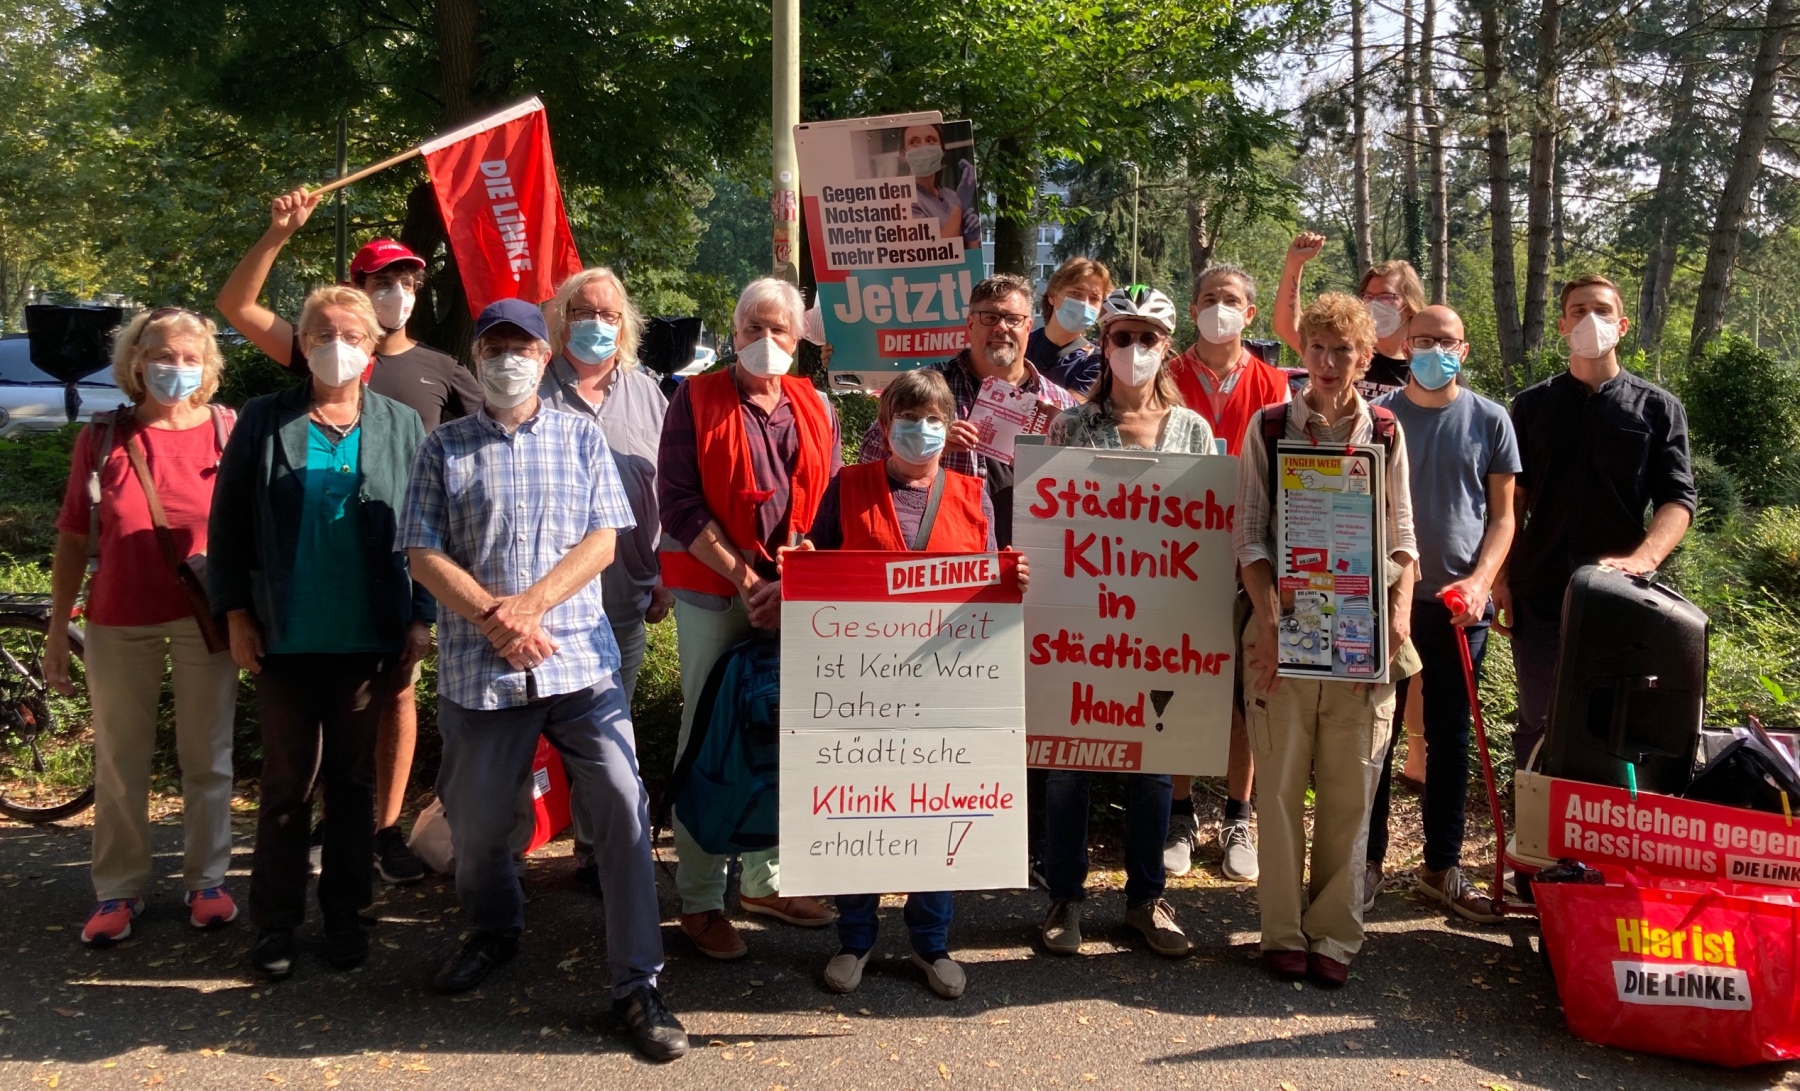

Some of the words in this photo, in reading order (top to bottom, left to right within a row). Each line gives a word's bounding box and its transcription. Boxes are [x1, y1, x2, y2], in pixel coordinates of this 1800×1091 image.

[481, 160, 515, 200] DIE
[822, 185, 876, 204] Gegen
[879, 183, 912, 200] den
[825, 203, 907, 224] Notstand:
[828, 227, 872, 245] Mehr
[875, 223, 935, 243] Gehalt,
[831, 247, 874, 265] mehr
[877, 242, 959, 264] Personal.
[834, 270, 972, 324] Jetzt!
[884, 335, 911, 352] DIE
[1284, 457, 1315, 468] FINGER
[1317, 459, 1341, 469] WEG!
[892, 565, 925, 590] DIE
[1098, 582, 1136, 620] in
[812, 606, 994, 640] Gesundheit
[816, 655, 846, 678] ist
[934, 651, 999, 679] Ware
[813, 691, 921, 719] Daher:
[816, 736, 971, 764] städtische
[1026, 740, 1054, 765] IE
[813, 784, 896, 815] Klinik
[910, 782, 1013, 813] Holweide
[1565, 793, 1706, 842] Aufstehen
[1713, 822, 1800, 858] gegen
[810, 829, 918, 857] erhalten
[1564, 821, 1717, 873] Rassismus
[1732, 860, 1760, 878] DIE
[1616, 918, 1687, 959] Hier
[1692, 925, 1736, 967] ist
[1624, 970, 1659, 997] DIE
